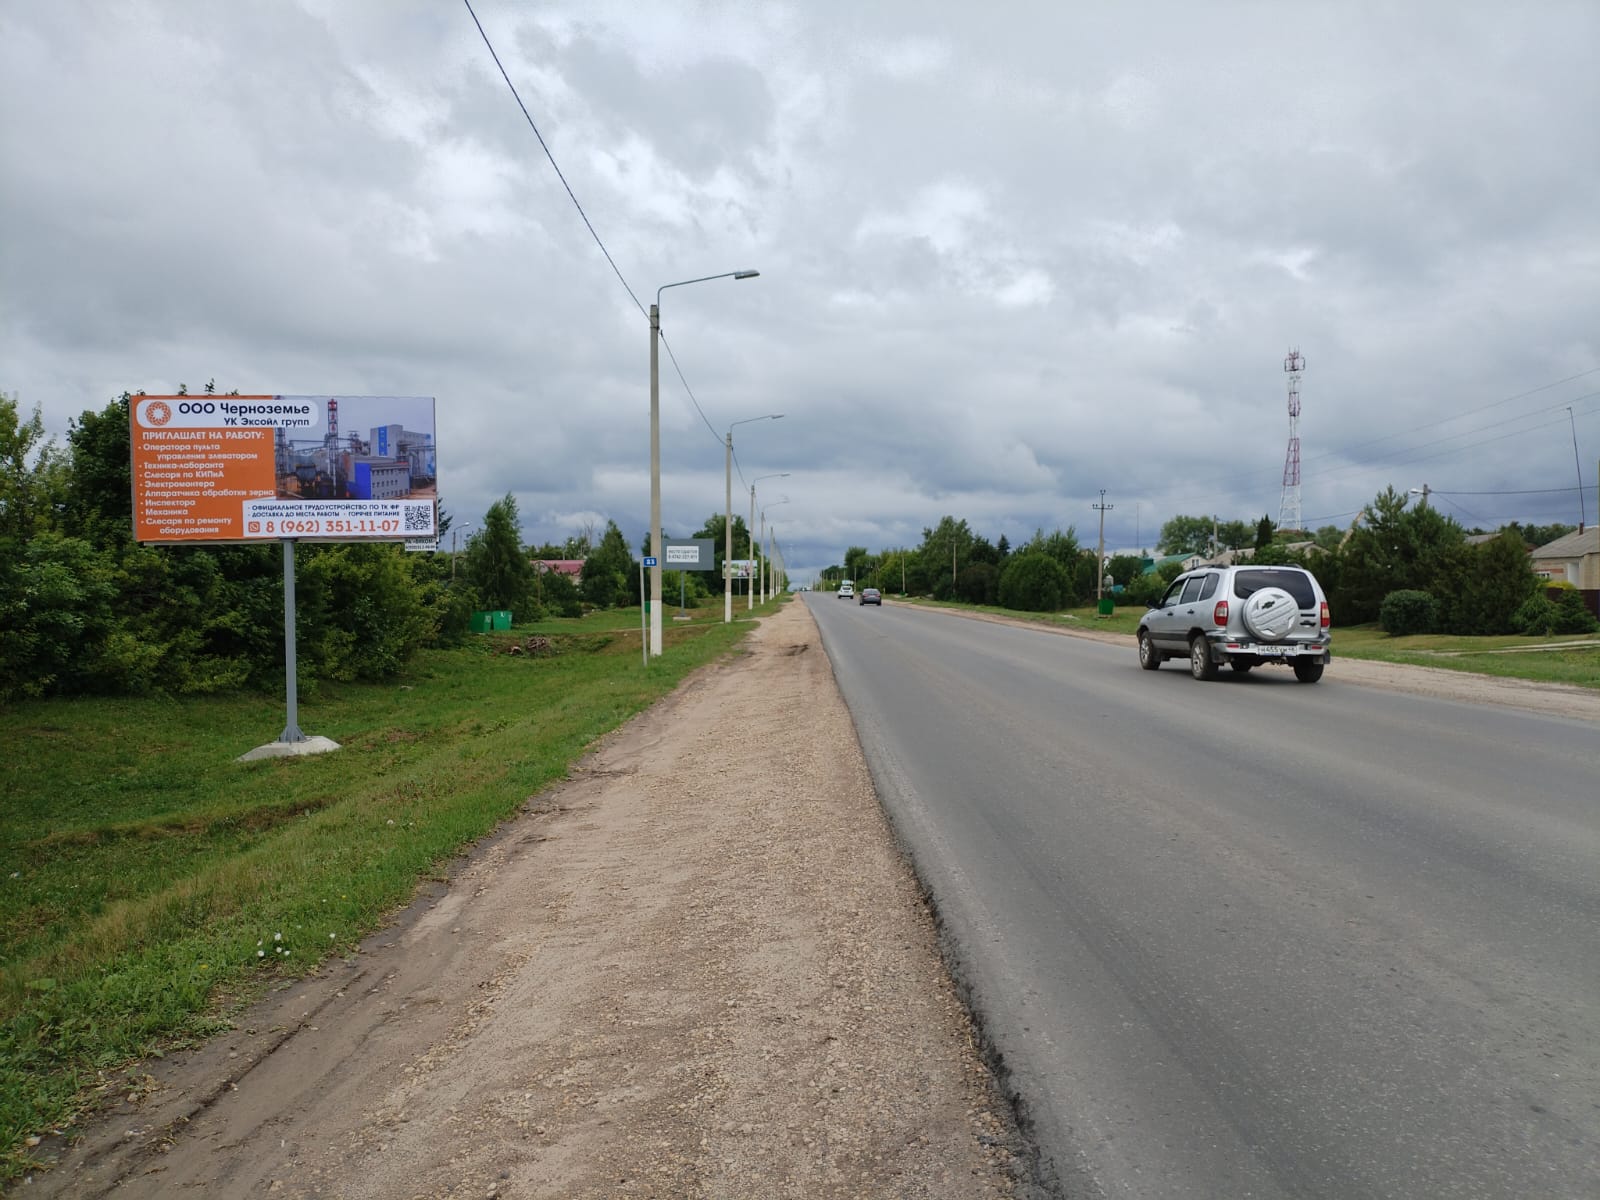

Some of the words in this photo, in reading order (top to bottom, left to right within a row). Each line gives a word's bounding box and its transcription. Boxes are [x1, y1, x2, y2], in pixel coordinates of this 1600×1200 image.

[179, 402, 215, 414] ООО
[220, 402, 310, 417] Черноземье
[224, 417, 237, 426] УК
[241, 416, 278, 427] Эксойл
[281, 418, 310, 428] групп
[142, 431, 206, 440] ПРИГЛАШАЕТ
[209, 431, 222, 440] НА
[226, 431, 265, 440] РАБОТУ:
[143, 443, 191, 452] Оператора
[193, 444, 220, 452] пульта
[157, 453, 206, 461] управления
[208, 452, 258, 460] элеватором
[144, 471, 181, 479] Слесаря
[144, 480, 215, 488] Электромонтера
[145, 489, 200, 498] Аппаратчика
[202, 489, 247, 497] обработки
[249, 489, 275, 497] зерна
[145, 499, 196, 507] Инспектора
[252, 504, 303, 512] ОФИЦИАЛЬНОЕ
[304, 503, 368, 511] ТРУДОУСТРОЙСТВО
[145, 508, 189, 516] Механика
[146, 517, 182, 526] Слесаря
[197, 518, 232, 526] ремонту
[160, 526, 219, 535] оборудования
[266, 521, 275, 532] 8
[280, 520, 320, 534] (962)
[325, 520, 400, 533] 351-11-07
